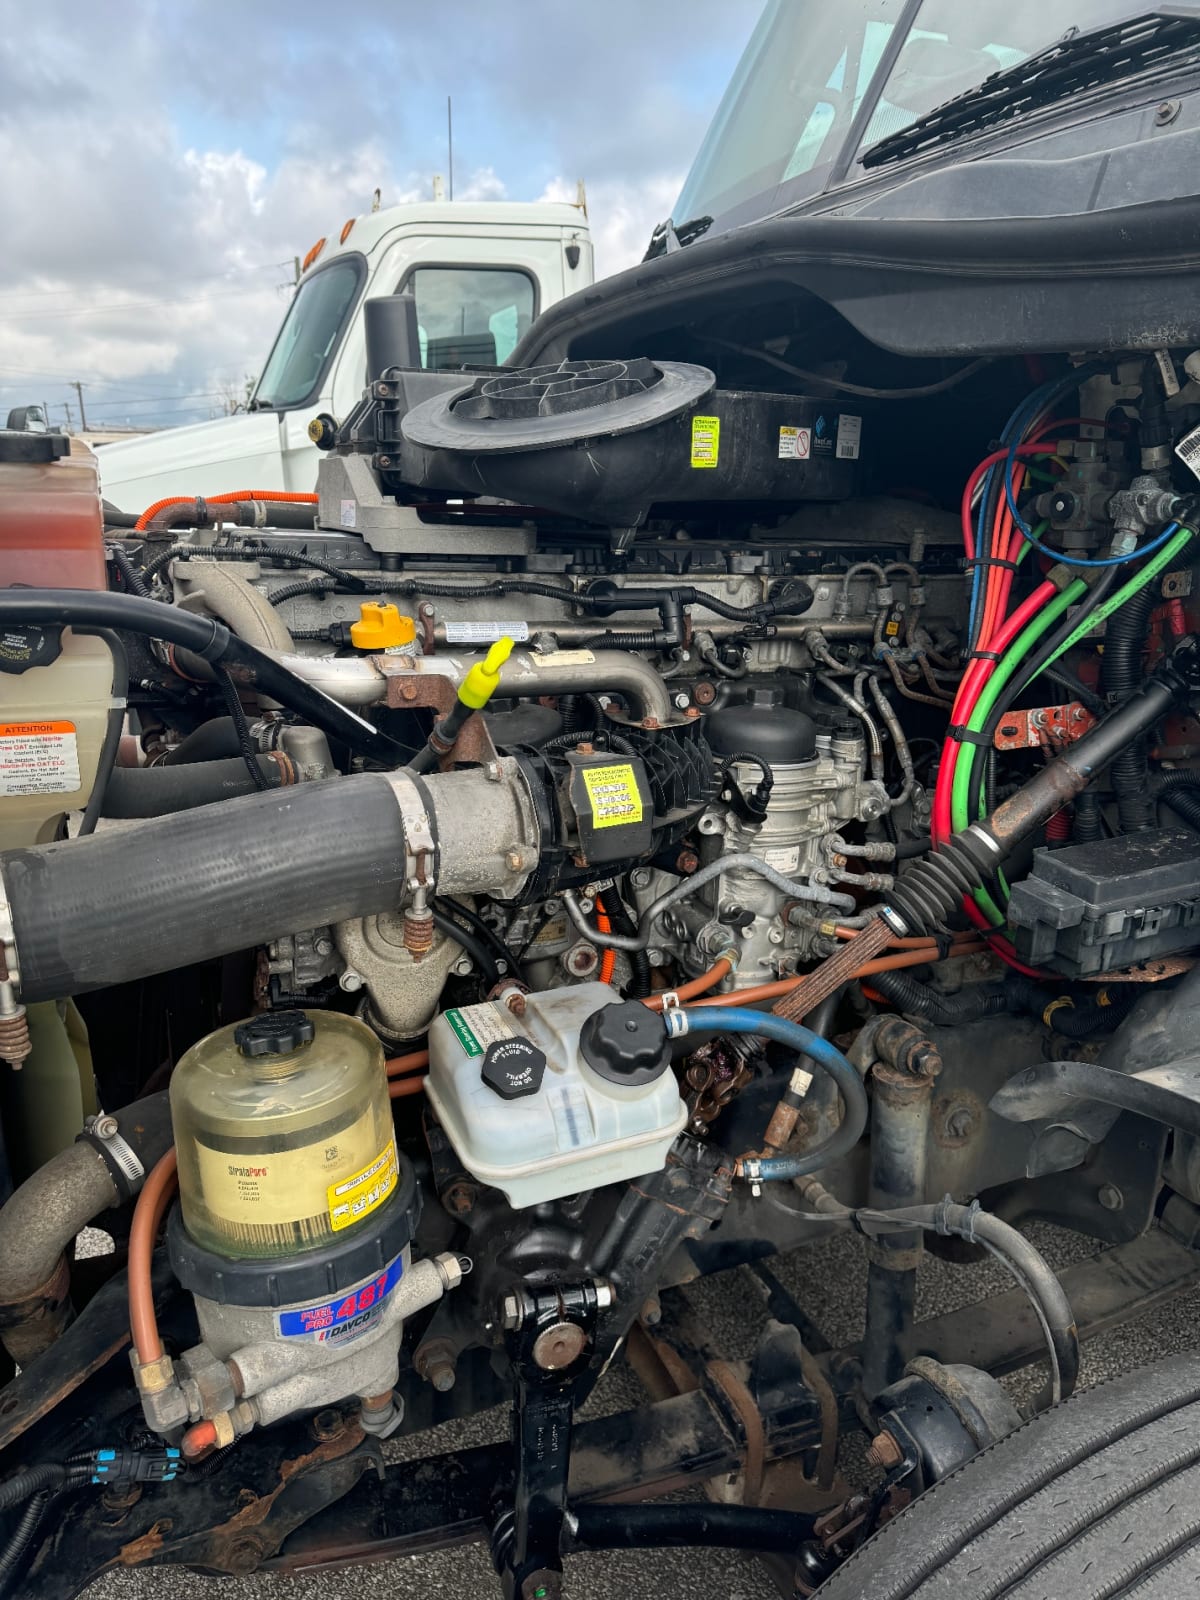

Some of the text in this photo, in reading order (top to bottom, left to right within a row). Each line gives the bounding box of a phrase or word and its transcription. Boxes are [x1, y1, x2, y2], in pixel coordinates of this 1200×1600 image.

[5, 725, 53, 733] ATTENTION
[491, 1043, 533, 1063] POWER STEERING
[501, 1049, 521, 1058] FLUID
[506, 1067, 532, 1080] OVERFILL
[523, 1076, 533, 1084] DO
[336, 1272, 388, 1319] 487
[300, 1305, 334, 1322] FUEL
[305, 1315, 334, 1331] PRO
[330, 1311, 371, 1337] DAVCO
